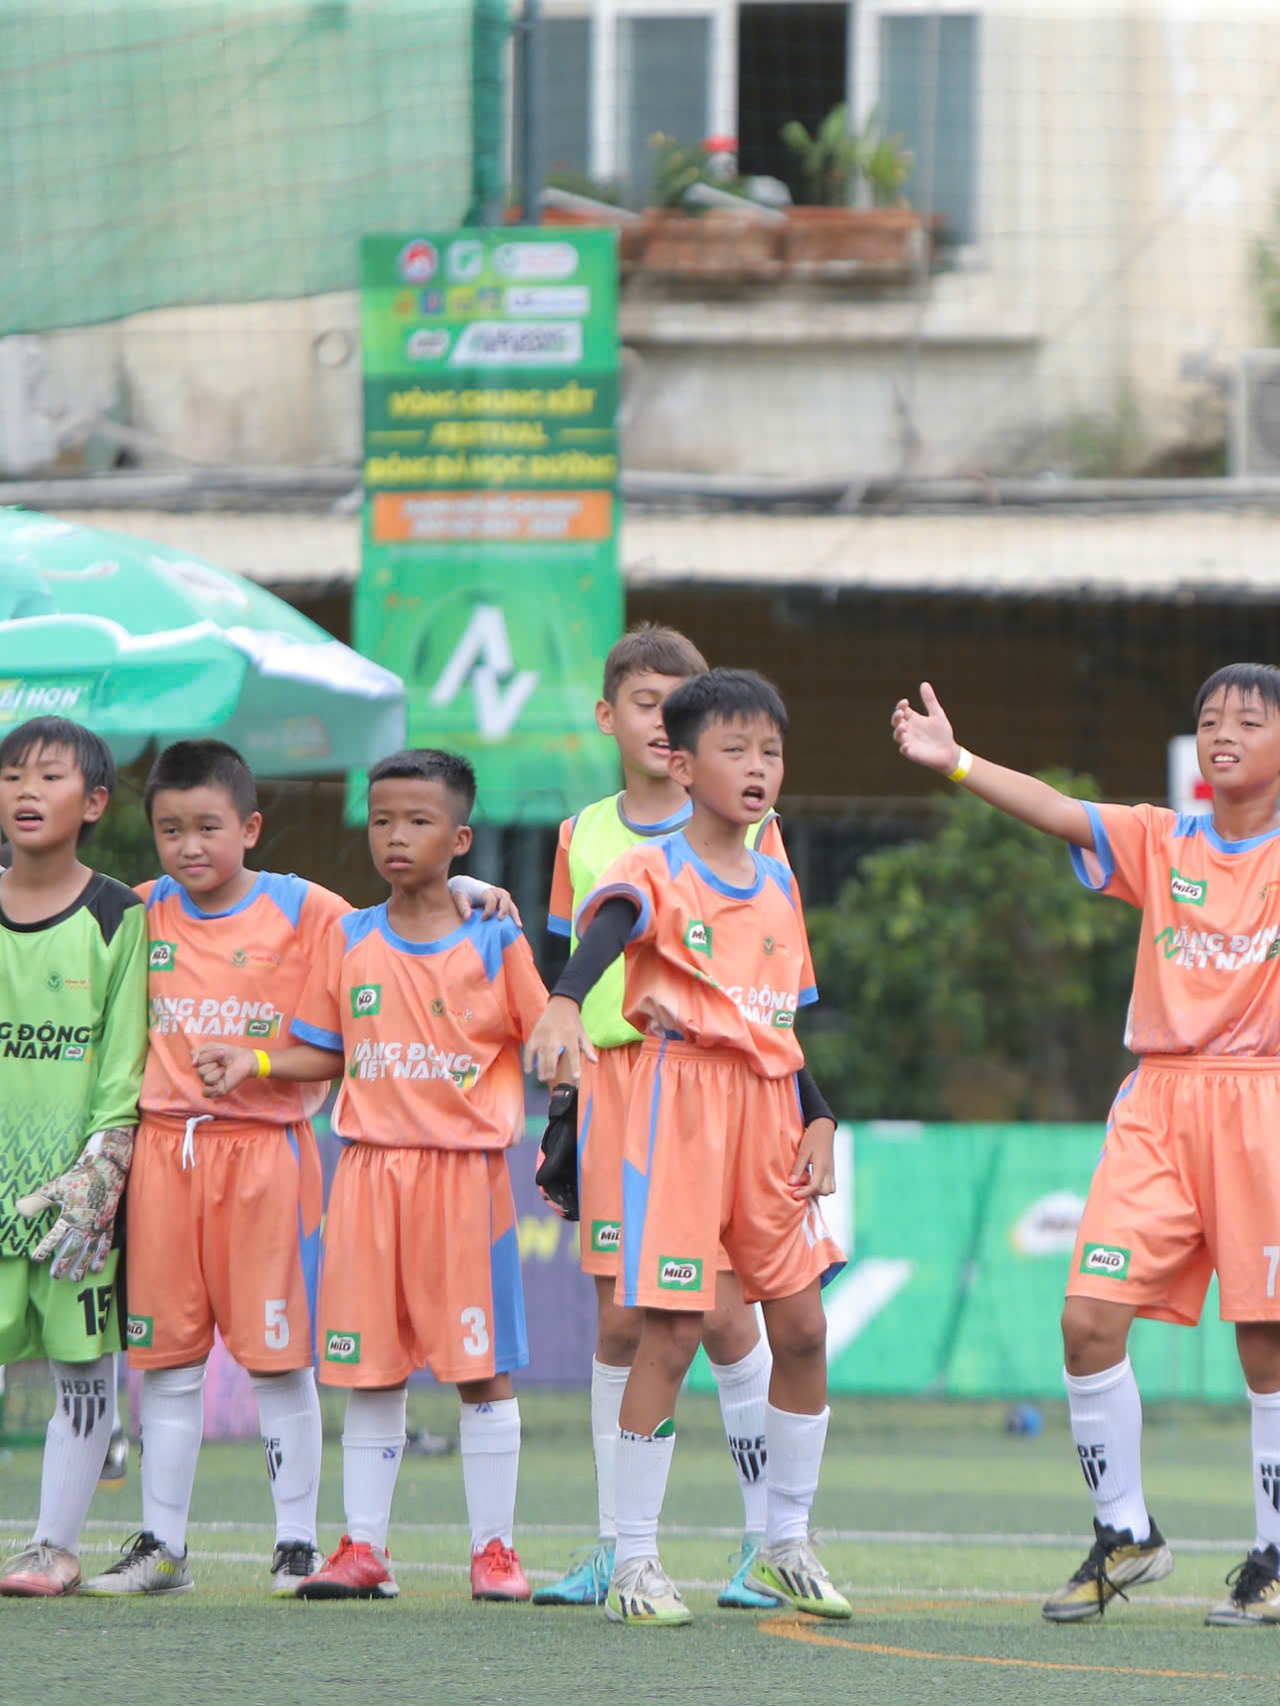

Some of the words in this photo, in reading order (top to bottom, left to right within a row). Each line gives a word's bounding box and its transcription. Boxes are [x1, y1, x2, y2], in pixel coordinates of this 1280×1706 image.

[184, 1017, 246, 1037] NAM
[4, 1040, 63, 1061] NAM
[664, 1267, 693, 1279] MILO
[1091, 1253, 1120, 1267] MILO
[1263, 1245, 1280, 1298] 7
[77, 1284, 112, 1336] 15
[264, 1299, 290, 1350] 5
[460, 1306, 490, 1357] 3
